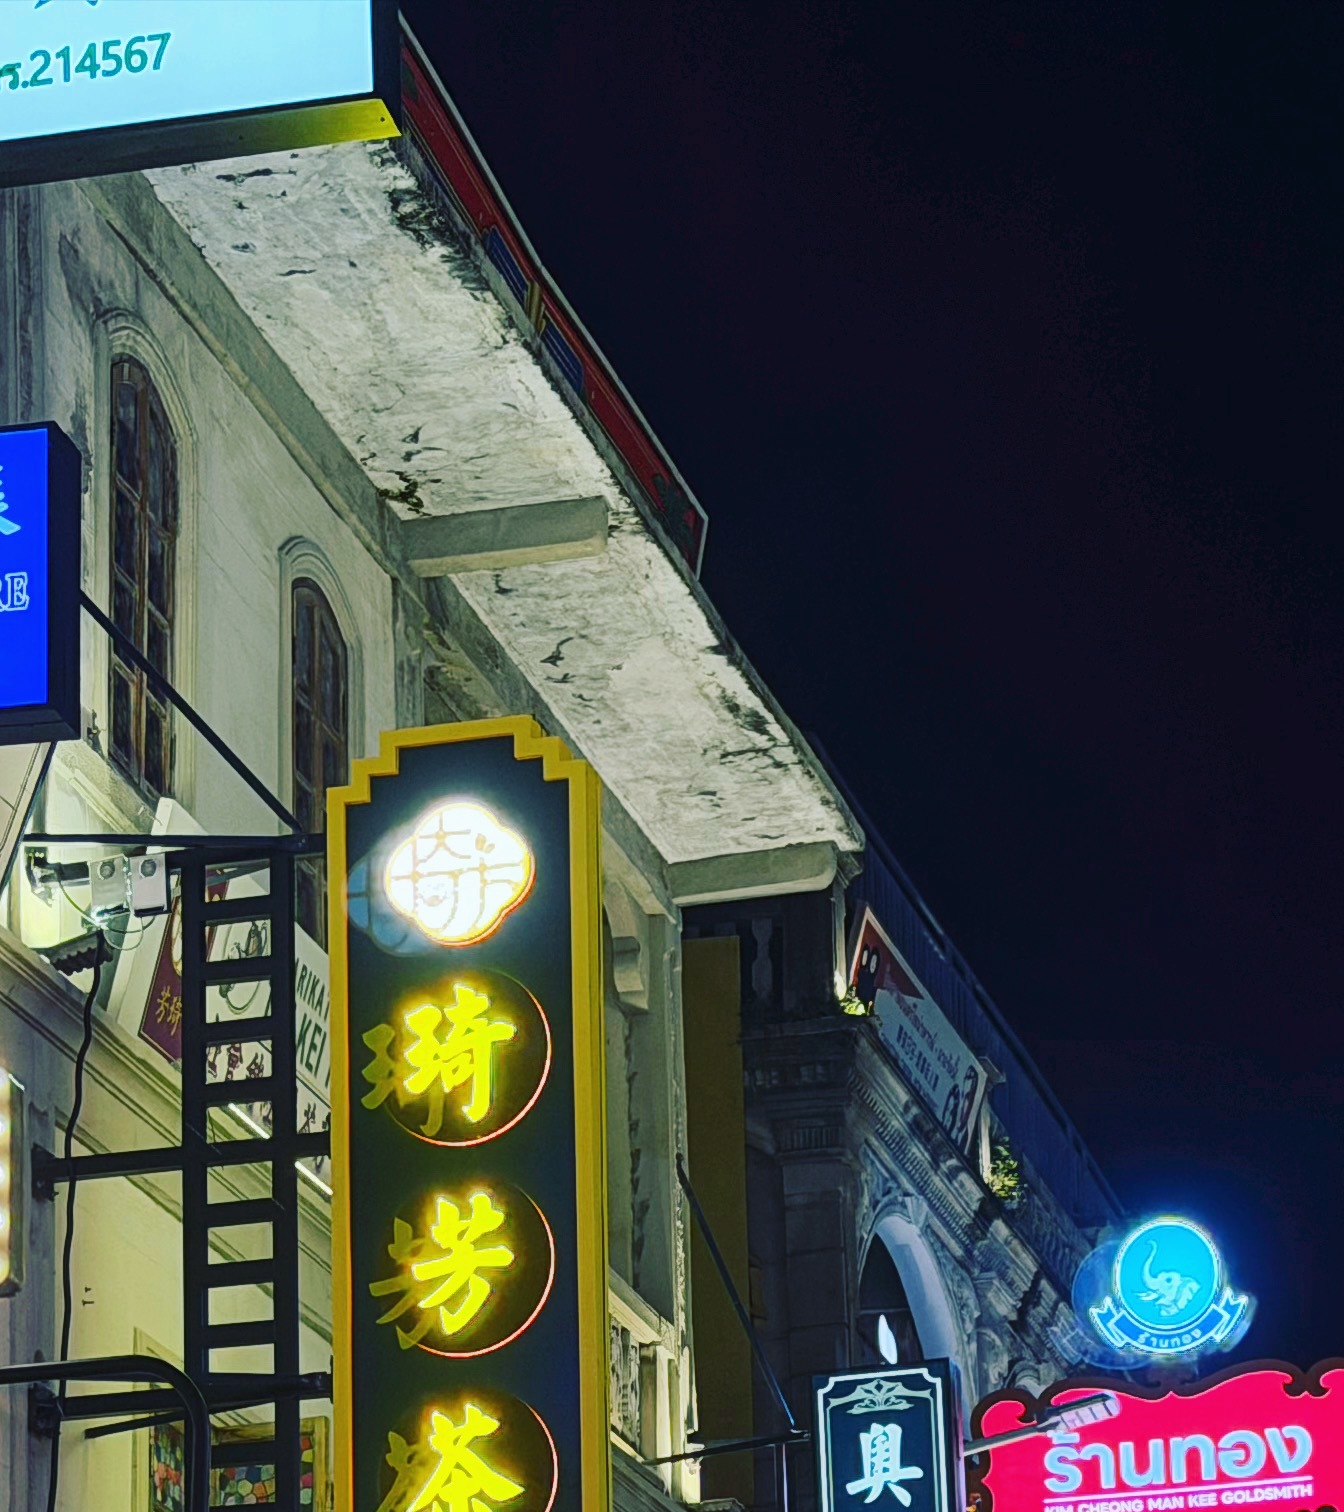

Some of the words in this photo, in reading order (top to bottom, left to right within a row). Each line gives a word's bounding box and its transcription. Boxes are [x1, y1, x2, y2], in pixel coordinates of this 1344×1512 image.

[1043, 1423, 1313, 1494] ร้านทอง
[1147, 1493, 1185, 1511] MAN
[1187, 1491, 1218, 1509] KEE
[1221, 1482, 1313, 1506] GOLDSMITH
